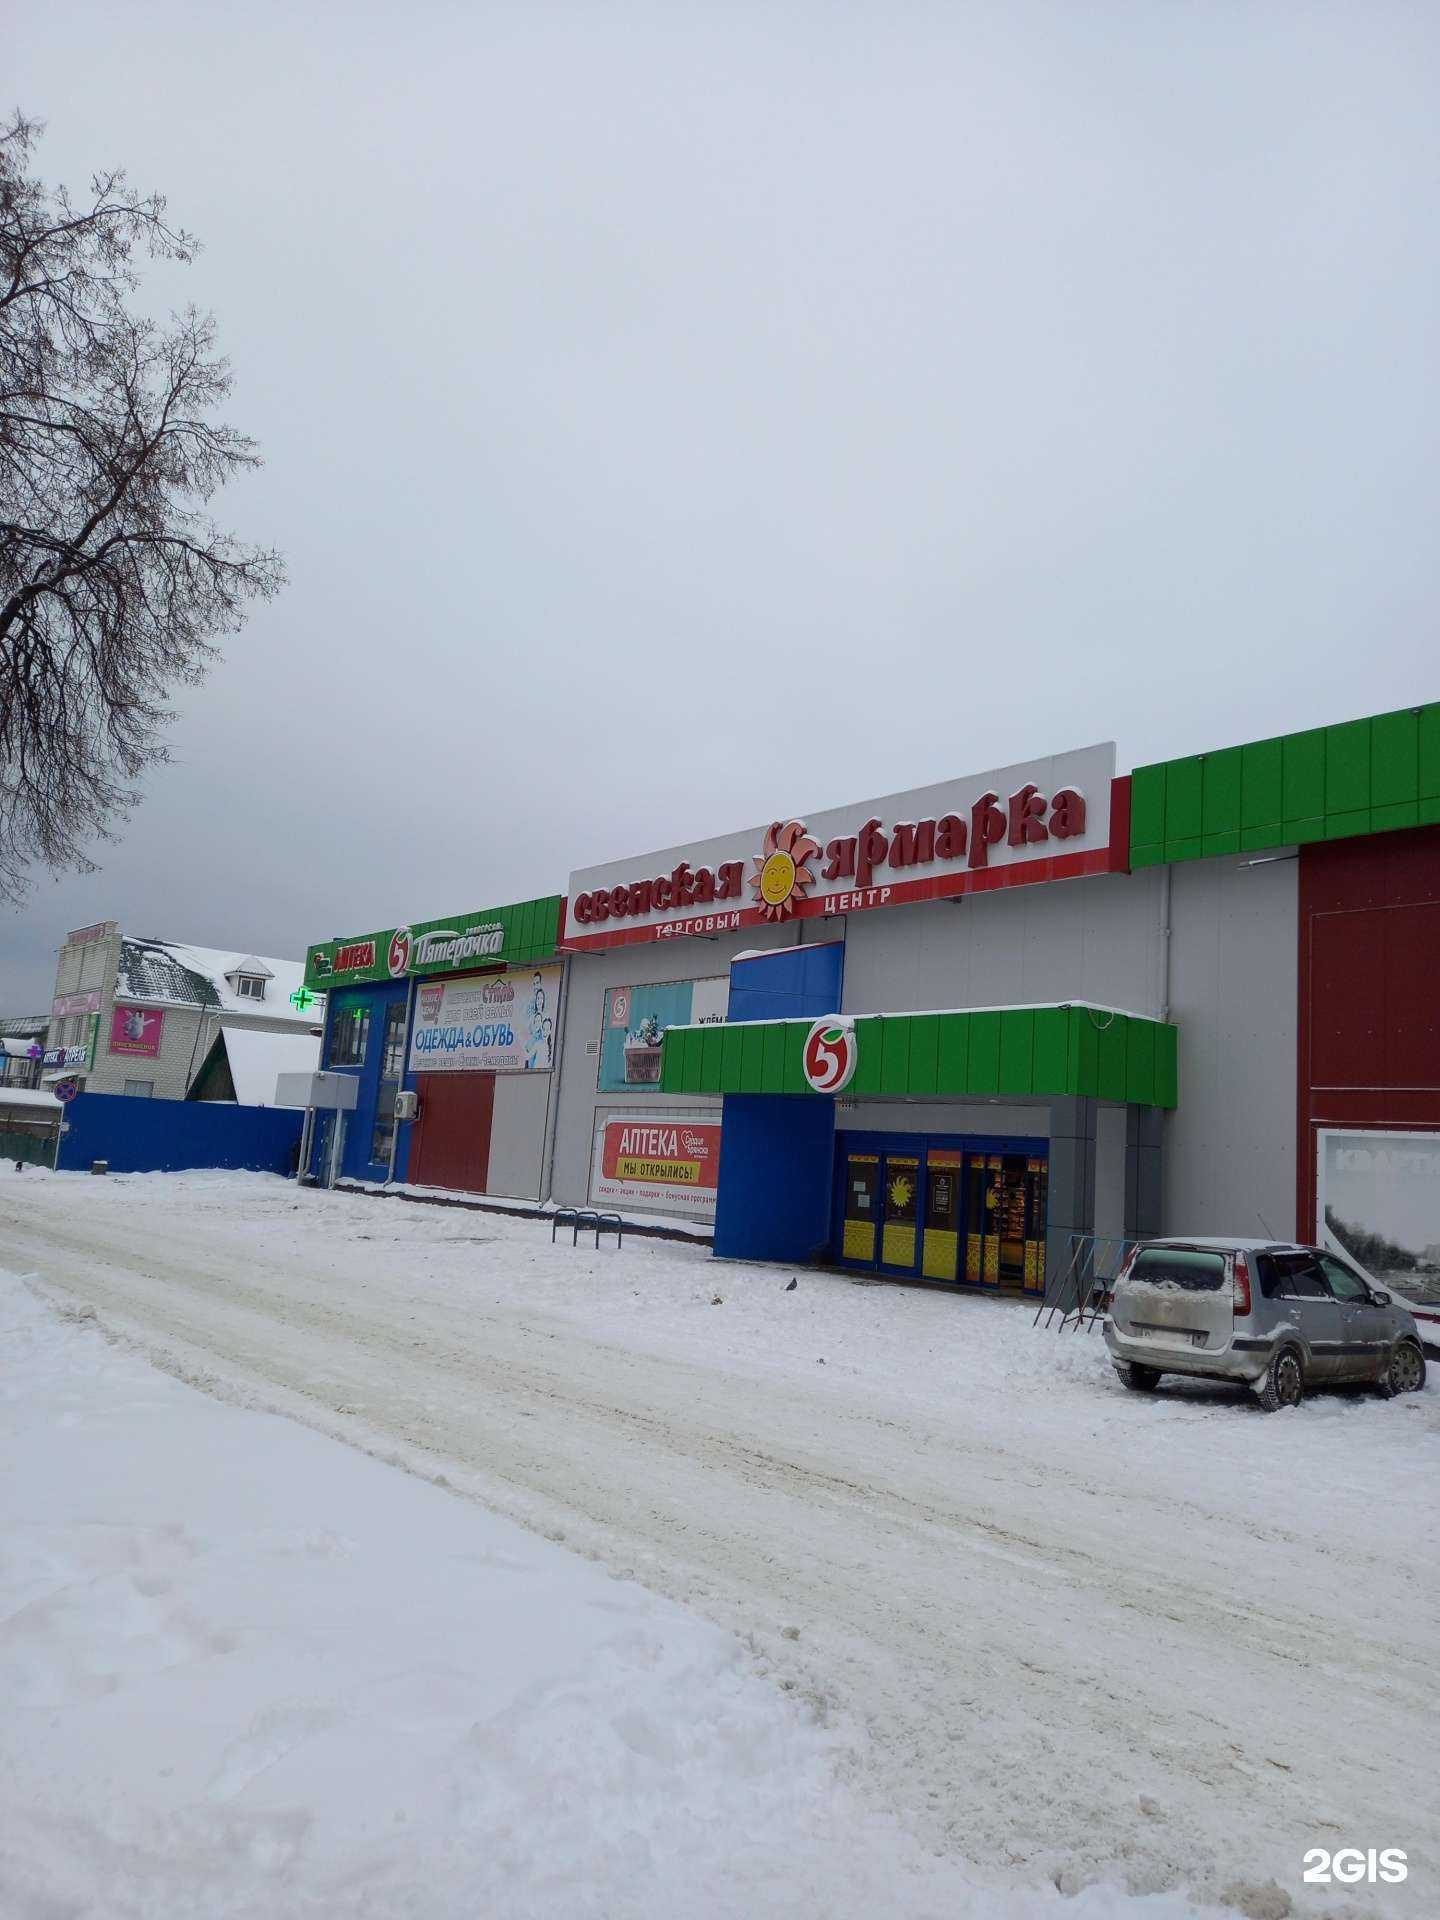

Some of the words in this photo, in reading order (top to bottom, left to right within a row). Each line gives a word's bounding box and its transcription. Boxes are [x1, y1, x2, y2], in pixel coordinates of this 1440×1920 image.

[821, 782, 1086, 888] ярмарка
[655, 911, 740, 938] ТОРГОВЫЙ
[824, 888, 890, 913] ЦЕНТР
[333, 941, 375, 973] АПТЕКА
[620, 1128, 679, 1156] АПТЕКА
[623, 1162, 636, 1176] МЫ
[640, 1163, 693, 1179] ОТКРЫЛИСЬ!
